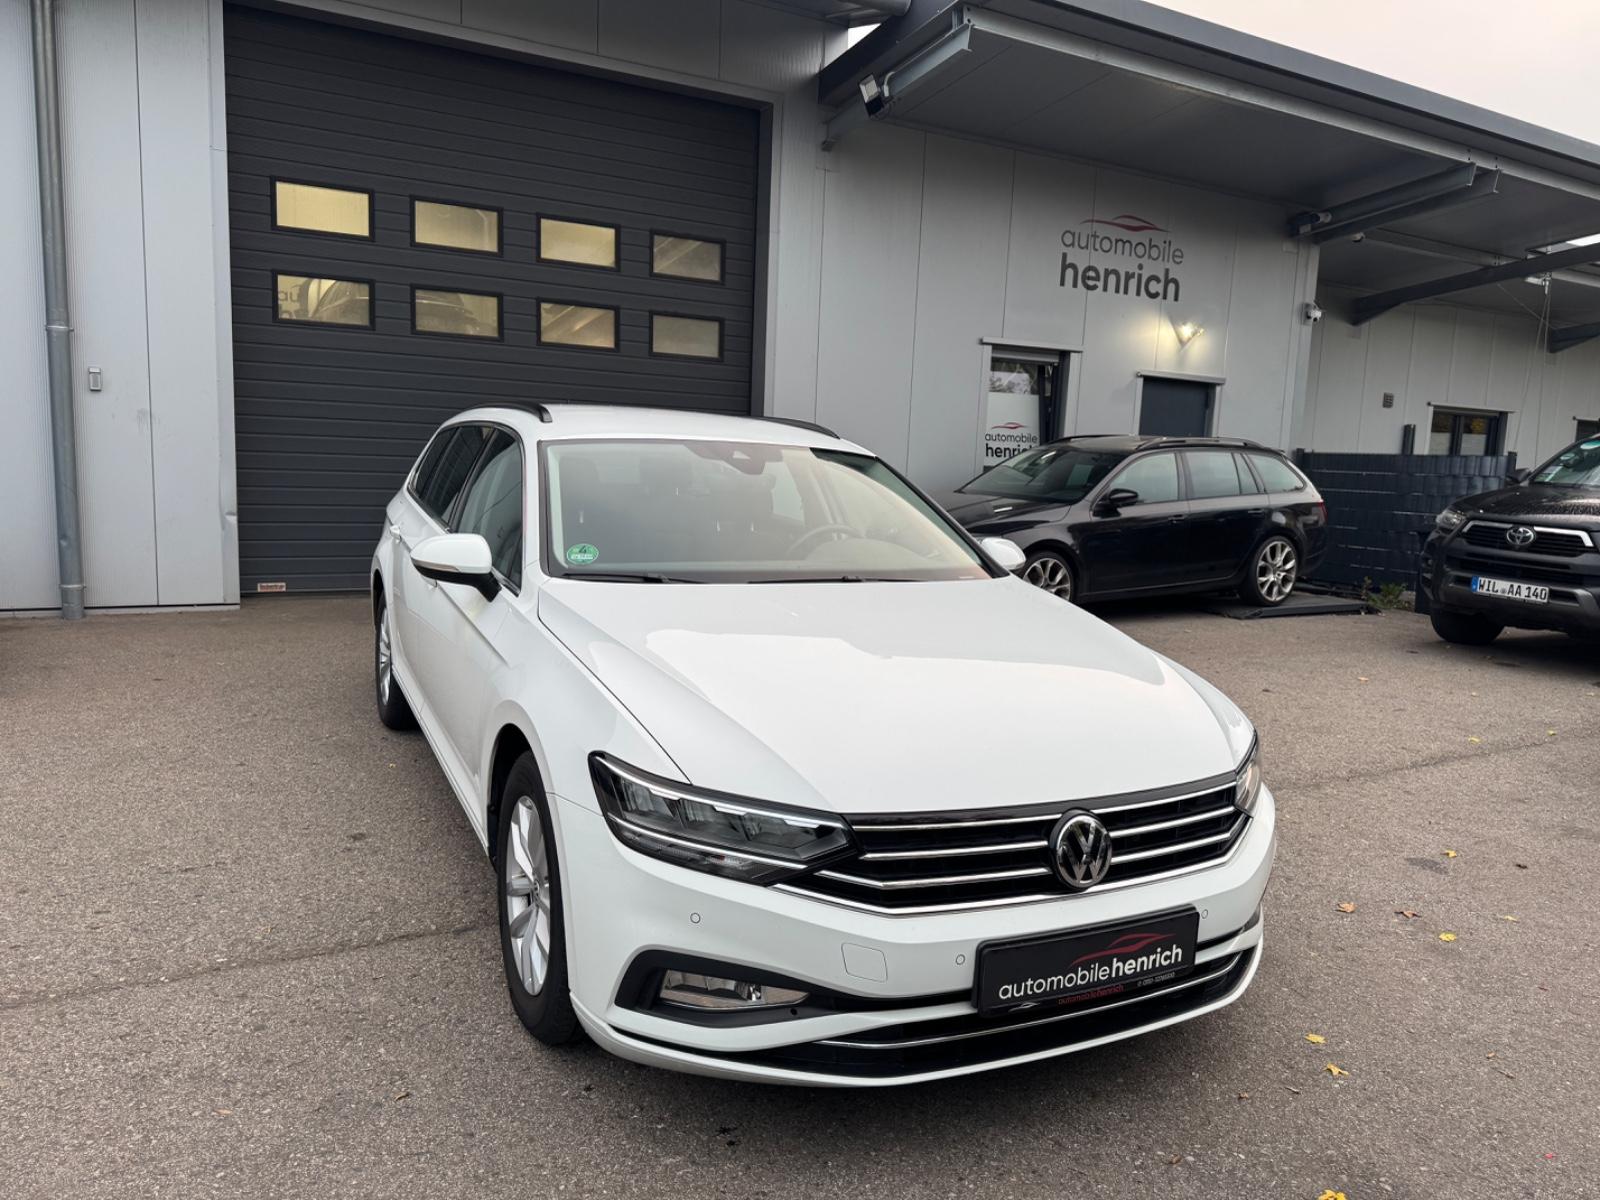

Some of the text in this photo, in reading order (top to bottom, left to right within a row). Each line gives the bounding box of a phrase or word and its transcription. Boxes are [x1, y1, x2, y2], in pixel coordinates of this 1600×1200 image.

[1061, 229, 1184, 265] automobile
[1060, 251, 1180, 302] henrich
[985, 433, 1038, 443] automobile
[985, 443, 1032, 458] henri
[1479, 578, 1547, 601] WIL AA 140
